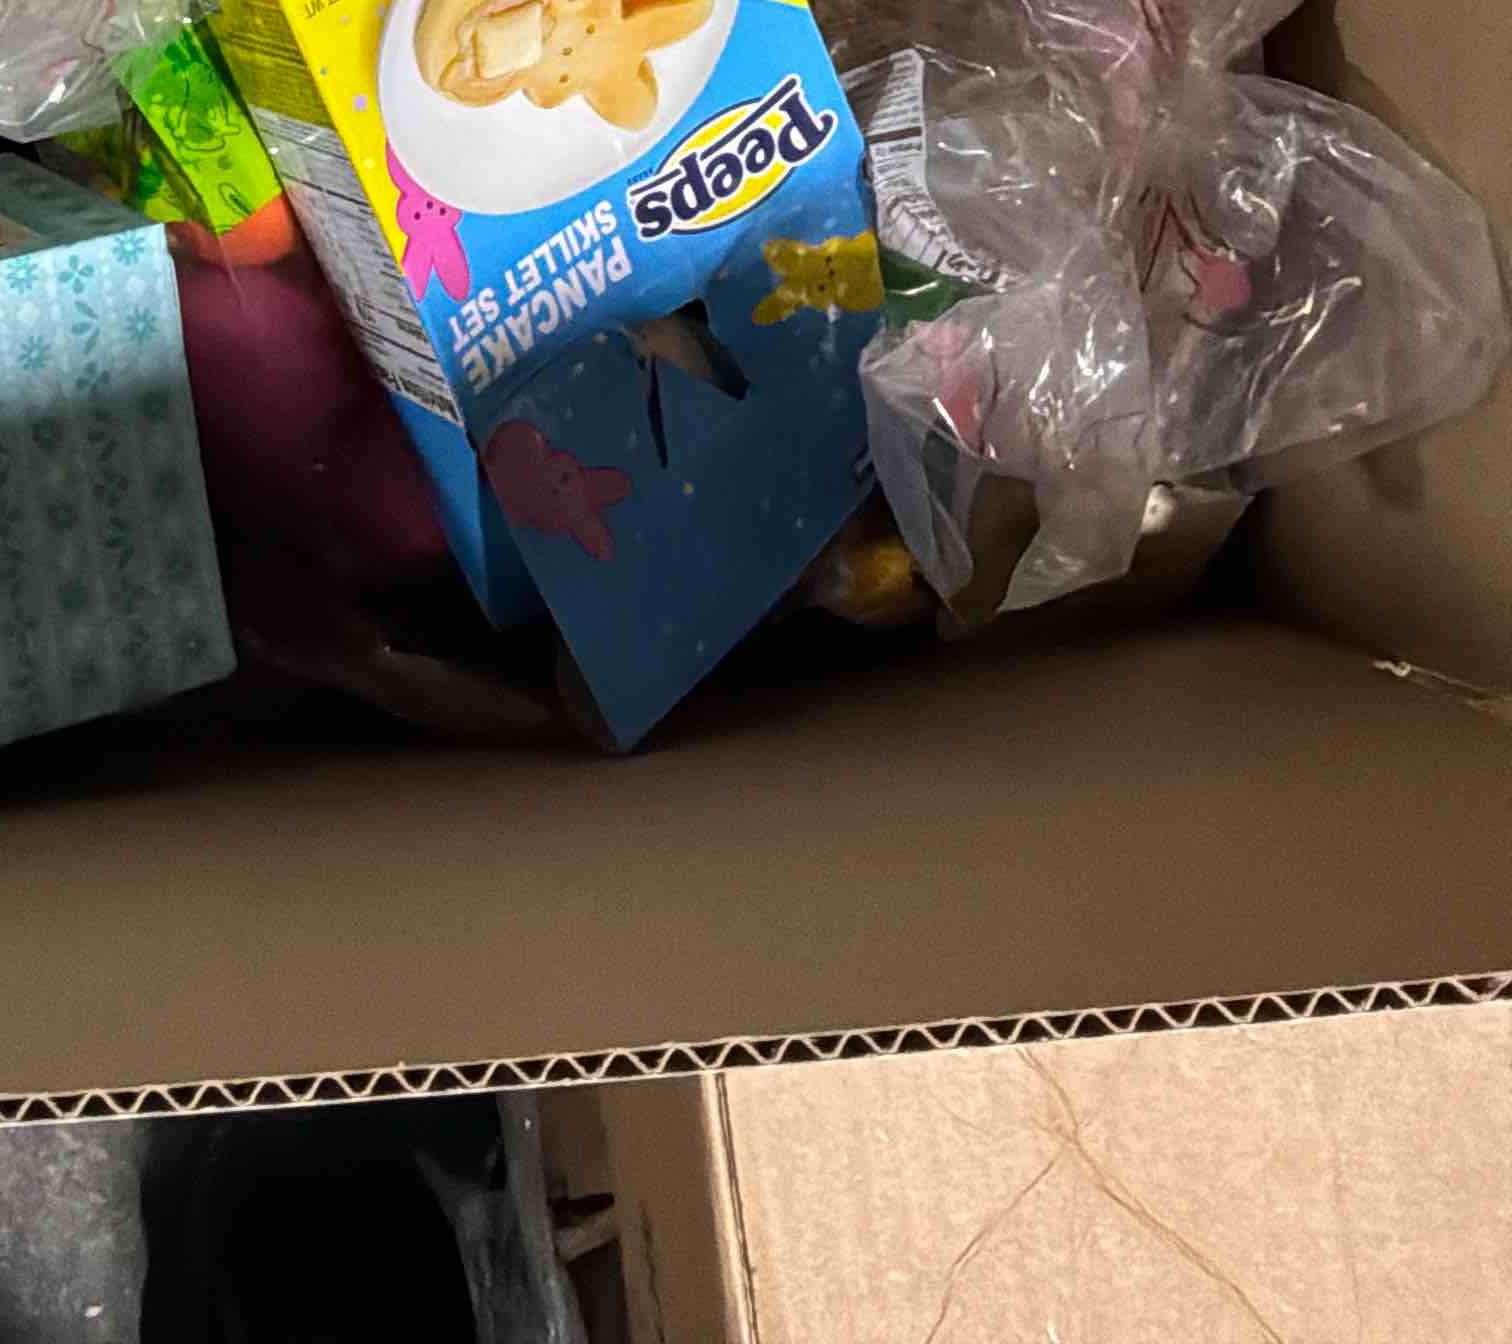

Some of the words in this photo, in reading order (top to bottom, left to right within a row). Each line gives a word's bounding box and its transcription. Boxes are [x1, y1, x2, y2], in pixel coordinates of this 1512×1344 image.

[633, 78, 836, 239] Peeps
[464, 239, 632, 388] PANCAKE
[504, 200, 617, 304] SKILLET
[449, 288, 501, 350] SET
